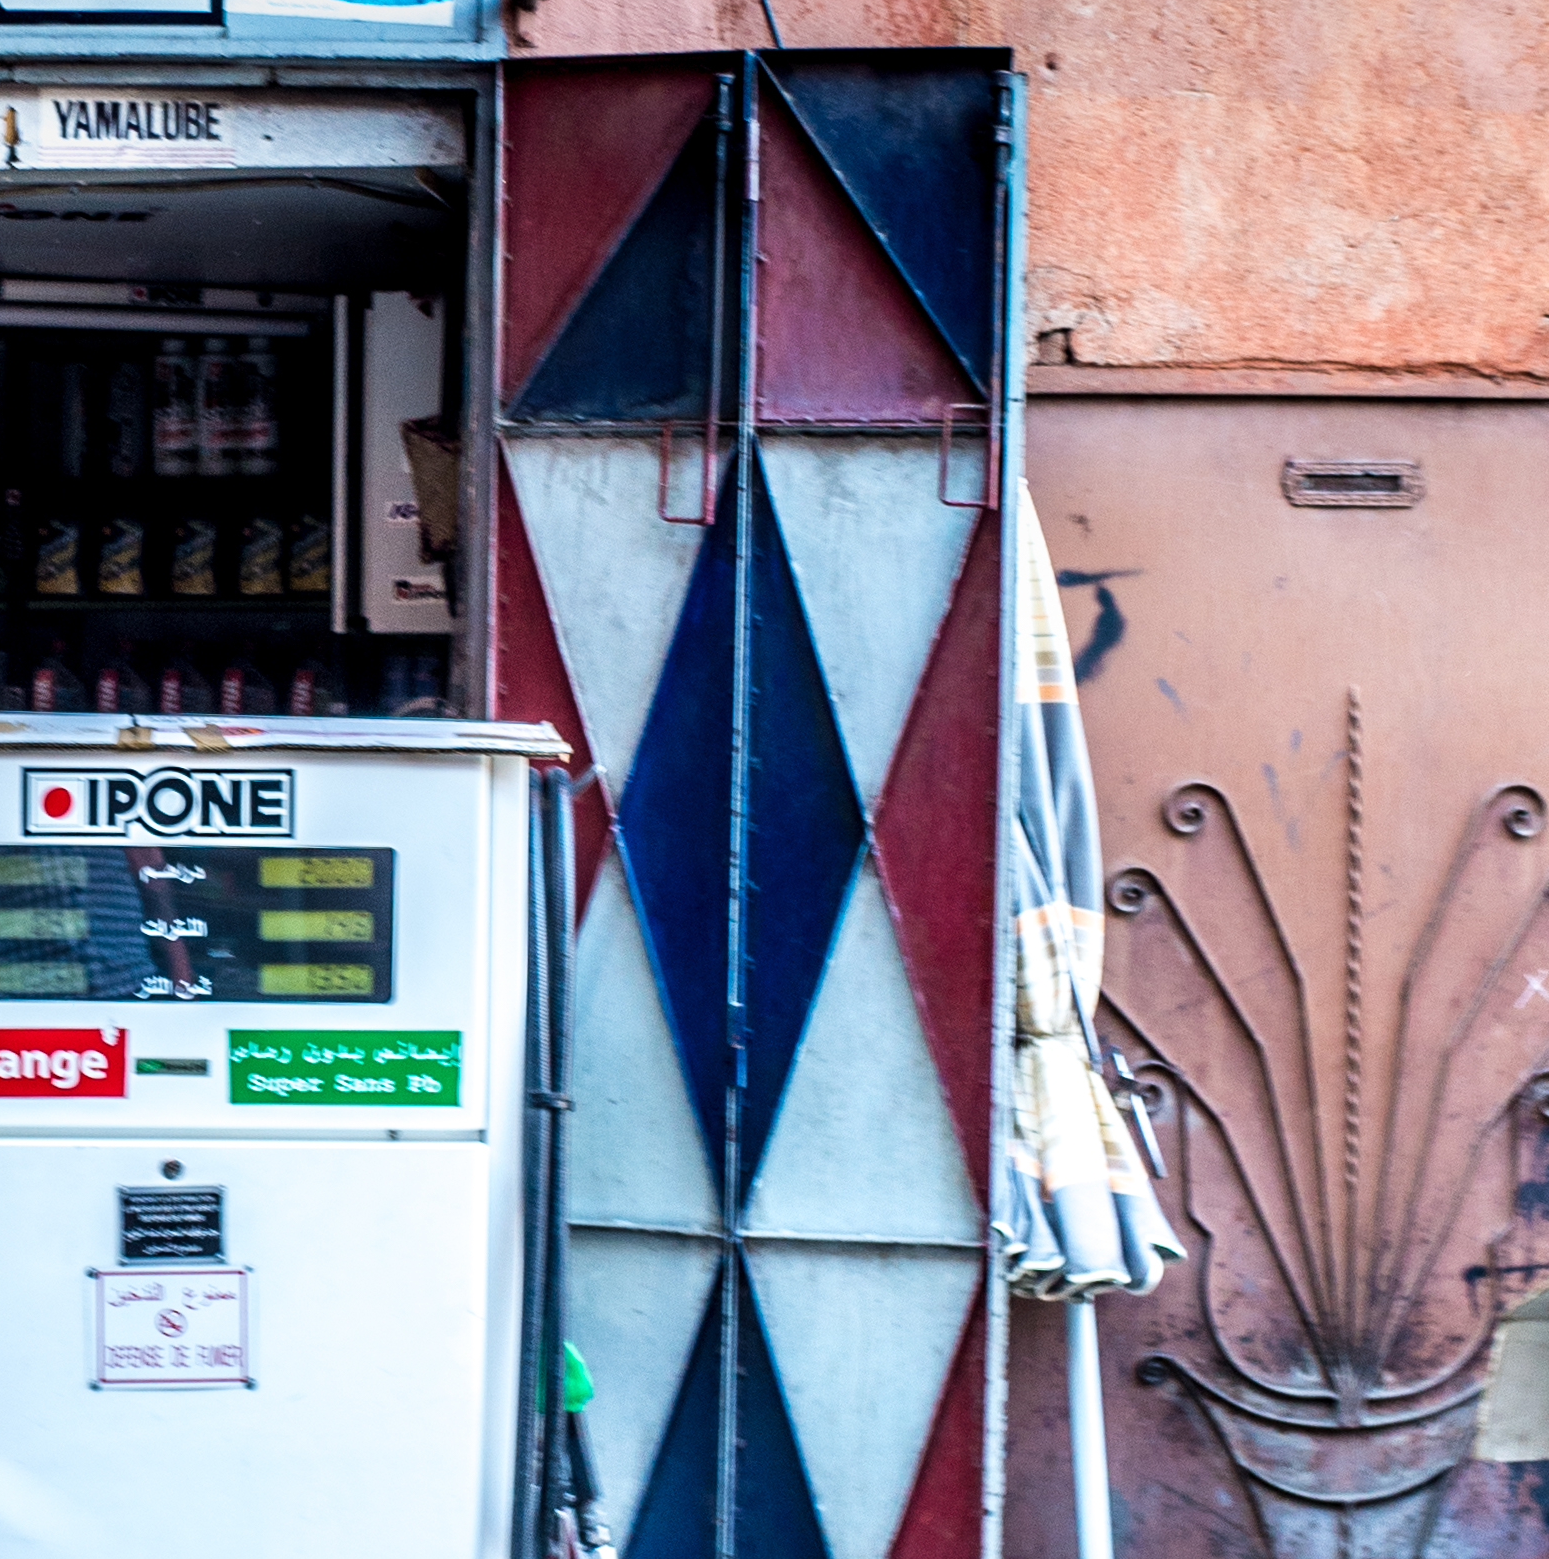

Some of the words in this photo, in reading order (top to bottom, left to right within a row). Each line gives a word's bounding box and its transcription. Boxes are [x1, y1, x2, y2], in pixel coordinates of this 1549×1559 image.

[53, 99, 223, 142] YAMALUBE
[89, 777, 285, 828] IPONE
[247, 1074, 324, 1098] Super
[334, 1074, 396, 1095] Sans
[406, 1074, 443, 1095] Pb
[104, 1344, 166, 1369] DEFENSE
[168, 1344, 191, 1369] DE
